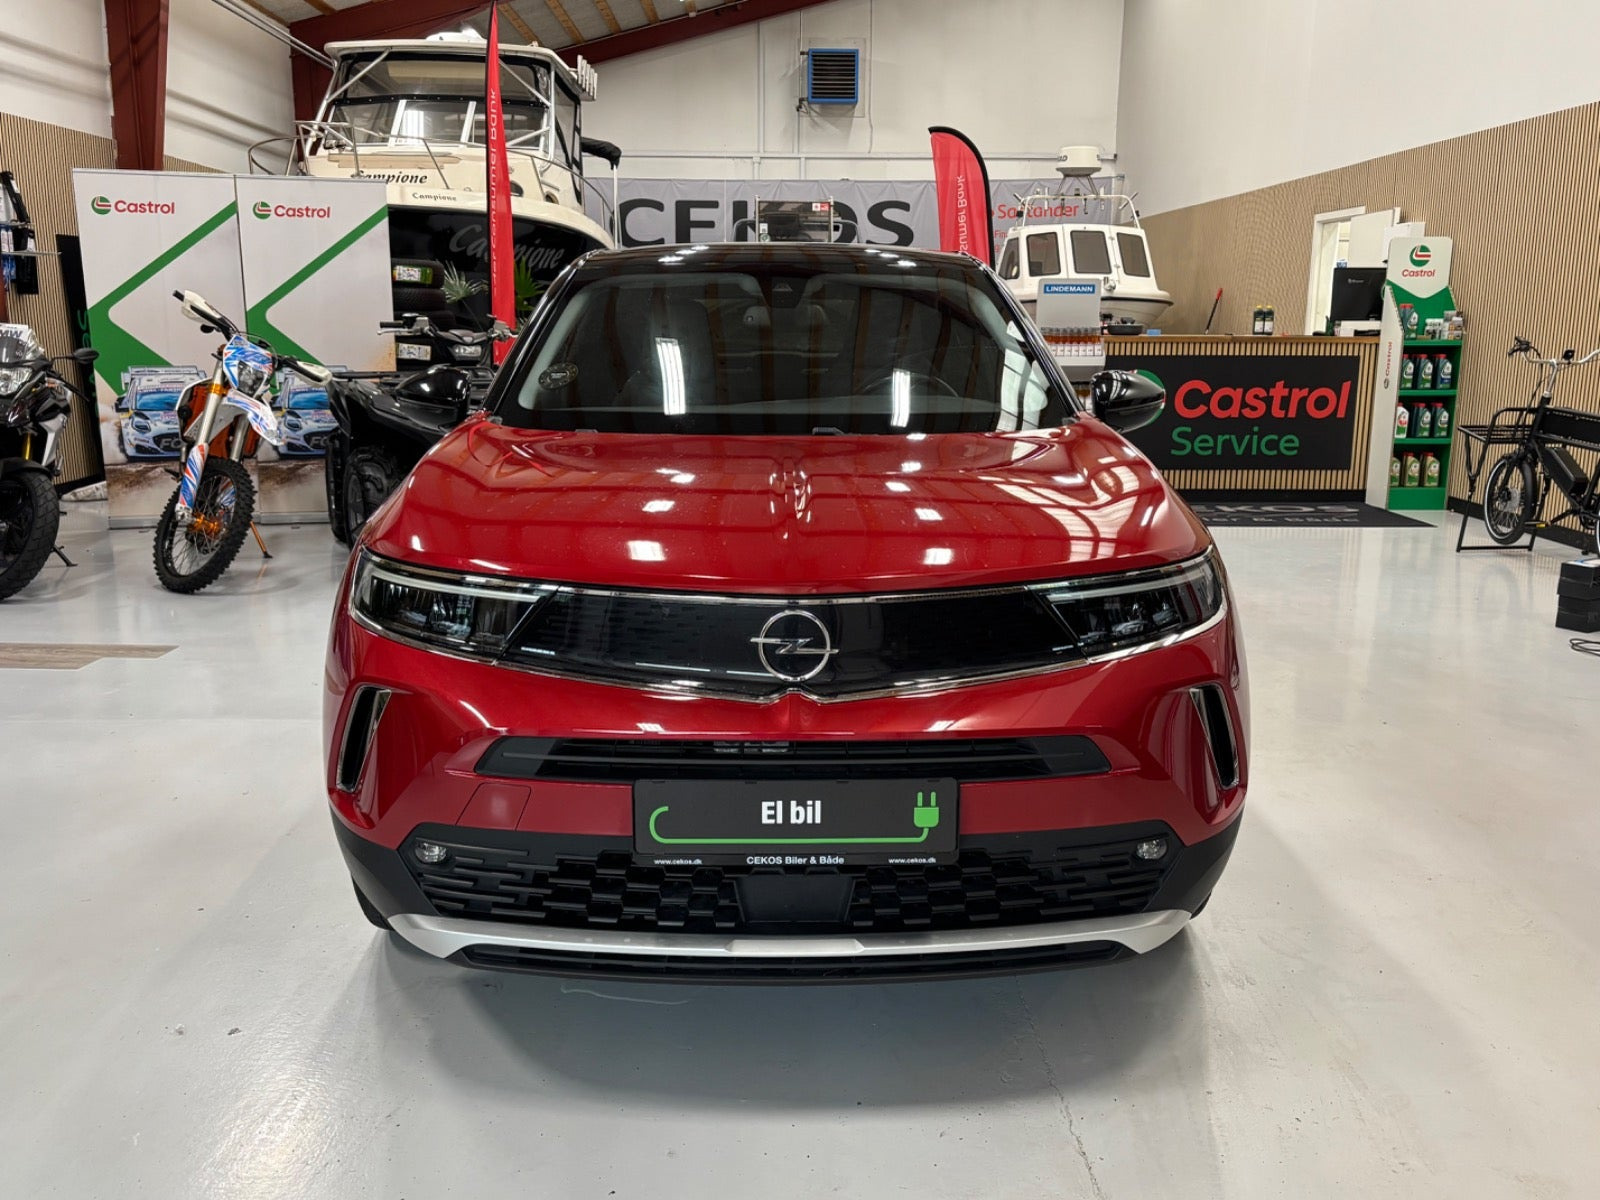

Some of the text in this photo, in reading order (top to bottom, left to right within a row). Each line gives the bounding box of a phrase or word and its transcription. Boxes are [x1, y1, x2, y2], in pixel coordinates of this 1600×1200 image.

[412, 193, 457, 202] Campione
[114, 200, 175, 214] Castrol
[274, 204, 331, 218] Castrol
[997, 203, 1080, 219] Satander
[449, 223, 565, 270] Caione
[1402, 269, 1436, 278] Castrol
[1045, 285, 1094, 293] LINDEMANN
[1174, 379, 1351, 419] Castrol
[1170, 426, 1300, 456] Service
[761, 800, 821, 824] El bil
[653, 858, 703, 866] www.cekos.dk
[746, 855, 845, 865] CEKOS Biler & Både
